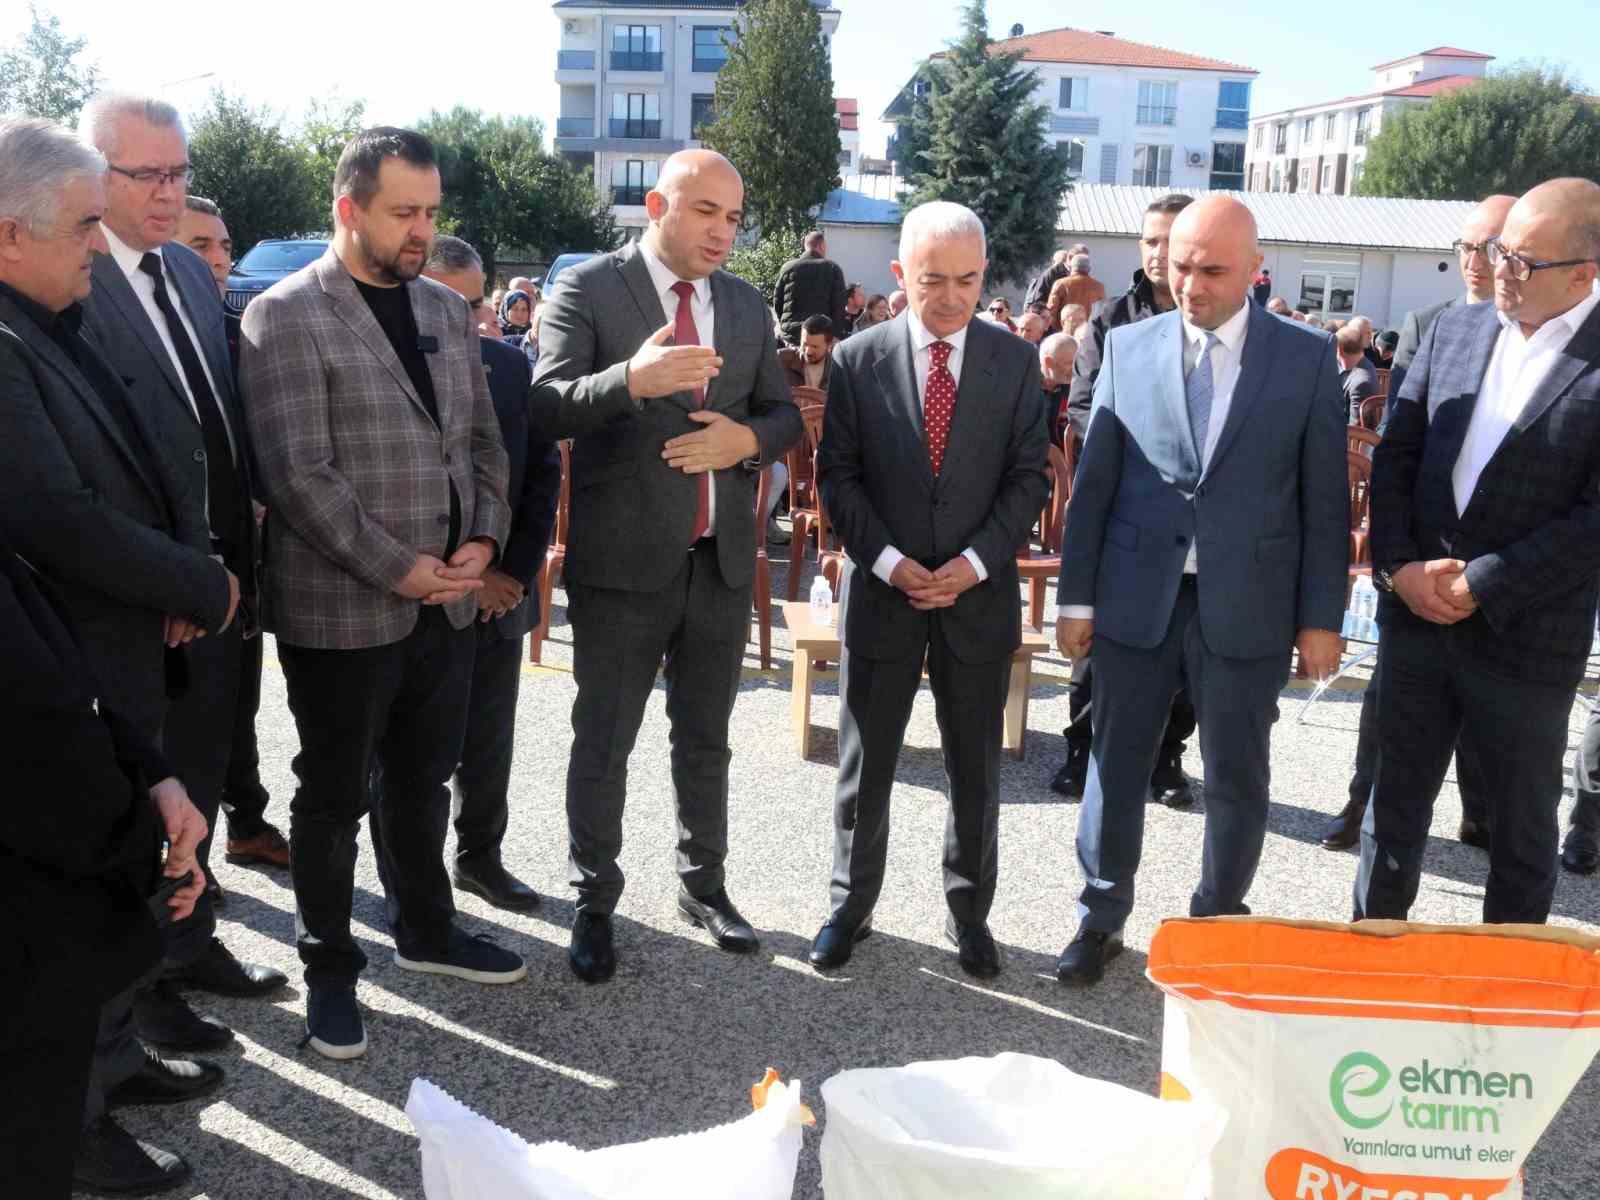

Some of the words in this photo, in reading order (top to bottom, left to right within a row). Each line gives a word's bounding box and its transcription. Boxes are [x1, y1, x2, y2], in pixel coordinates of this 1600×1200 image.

[1399, 1058, 1533, 1099] ekmen
[1400, 1095, 1500, 1134] tarım
[1422, 1144, 1472, 1161] umut
[1477, 1147, 1516, 1163] eker
